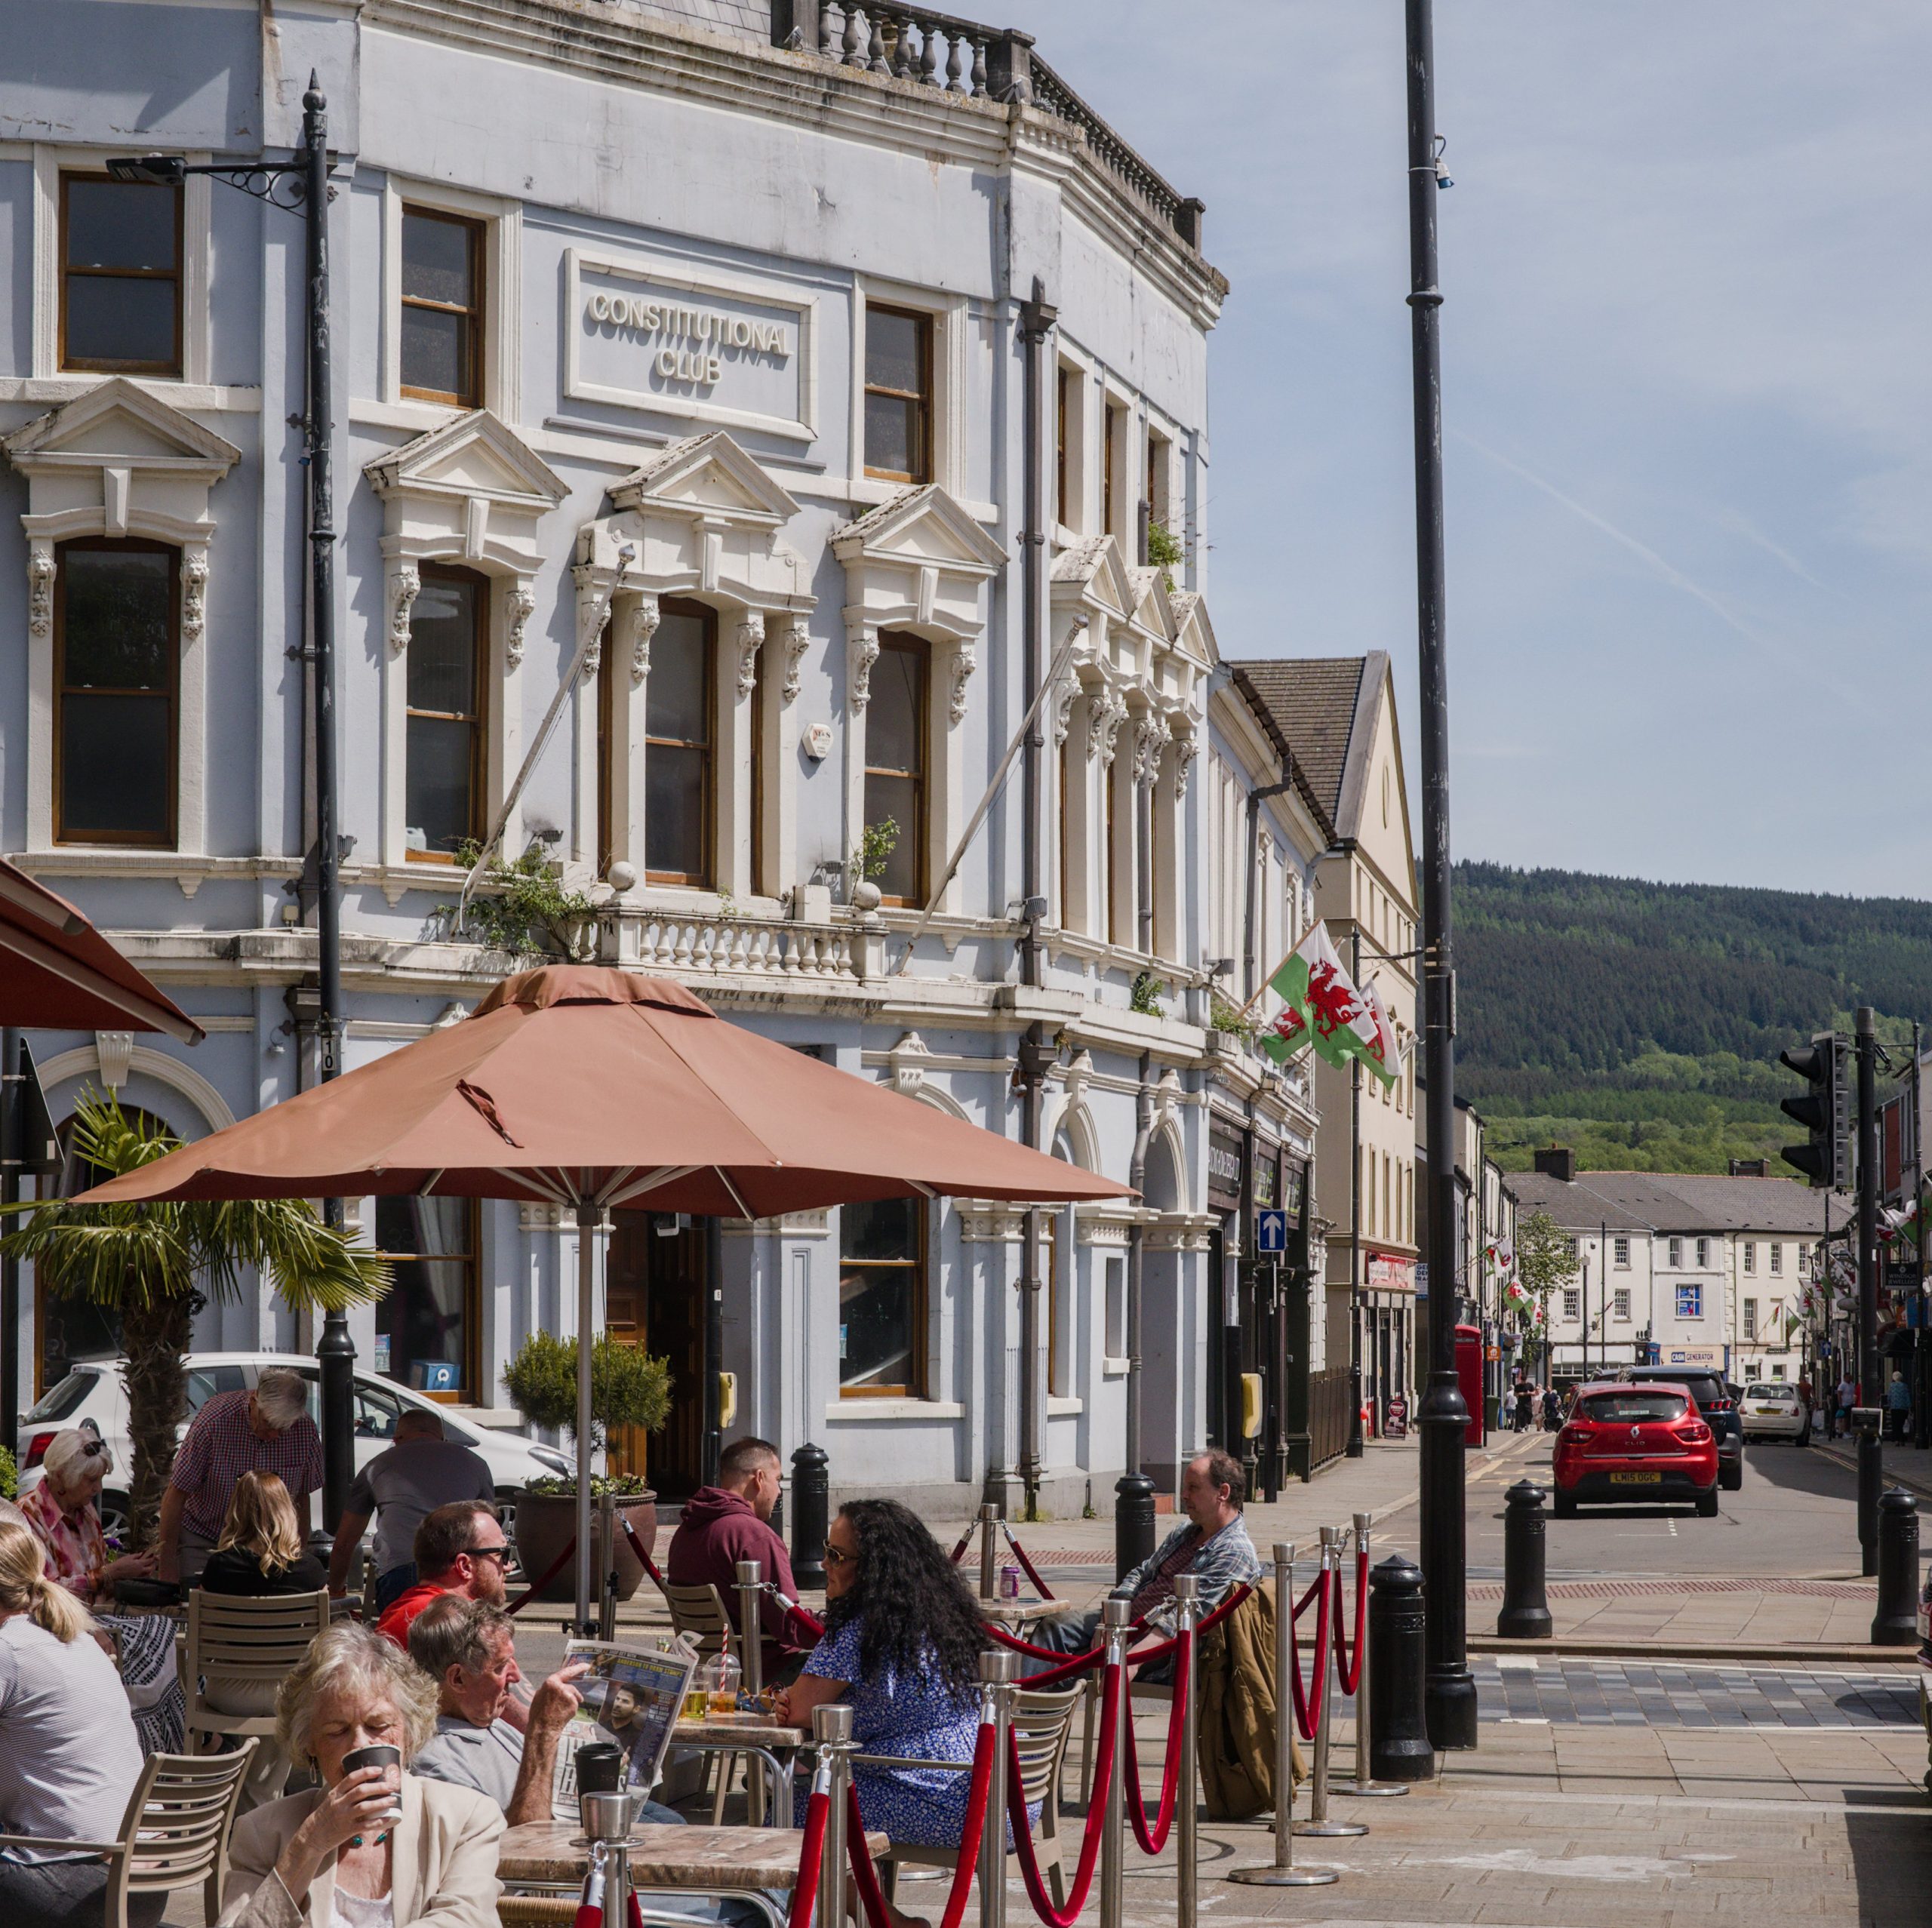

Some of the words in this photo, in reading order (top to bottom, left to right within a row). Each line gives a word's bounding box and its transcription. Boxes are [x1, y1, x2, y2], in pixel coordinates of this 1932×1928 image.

[586, 294, 794, 356] CONSTITUTIONAL
[655, 348, 722, 385] CLUB
[1672, 1353, 1685, 1361] CASH
[1615, 1473, 1635, 1481] LM15
[1638, 1473, 1655, 1481] OGC
